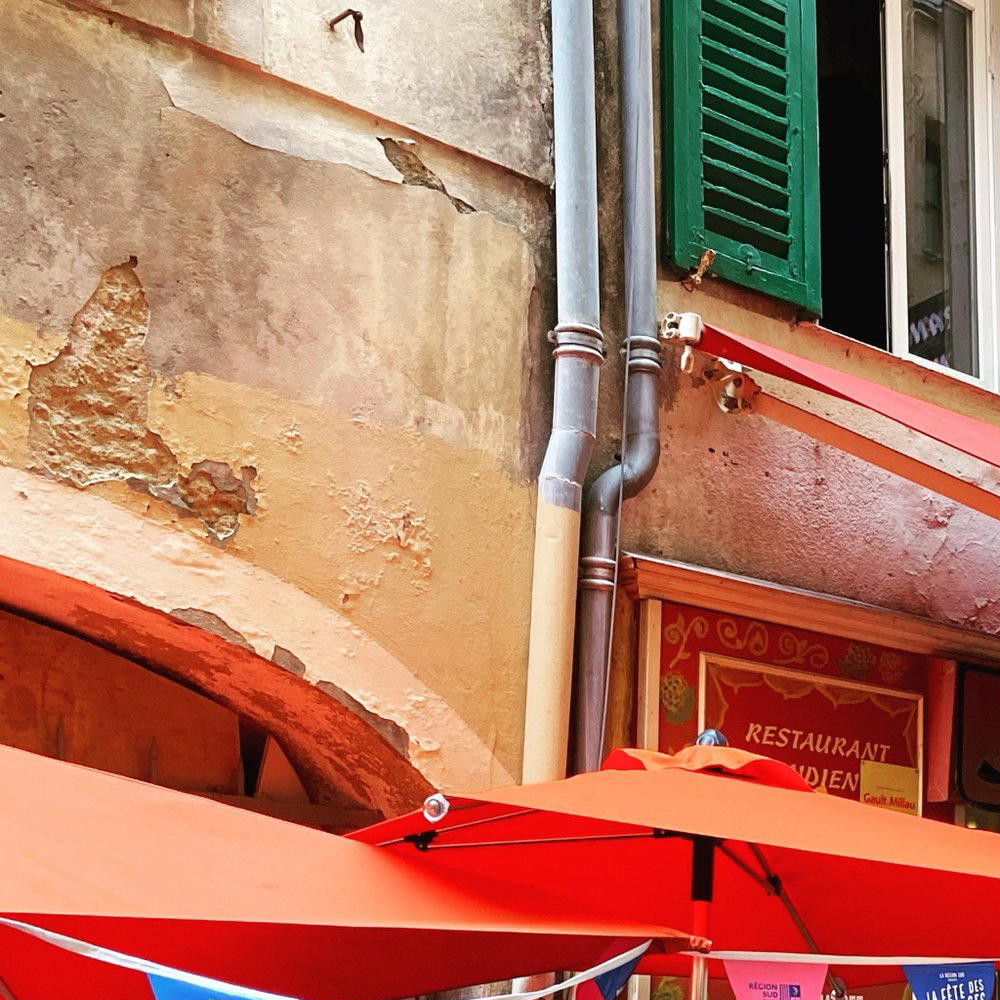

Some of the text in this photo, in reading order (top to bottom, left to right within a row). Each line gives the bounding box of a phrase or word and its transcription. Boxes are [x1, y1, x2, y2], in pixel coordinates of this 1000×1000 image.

[745, 722, 890, 762] RESTAURANT
[789, 764, 859, 791] DIEN
[748, 982, 778, 991] RÉGION
[968, 978, 984, 993] DES
